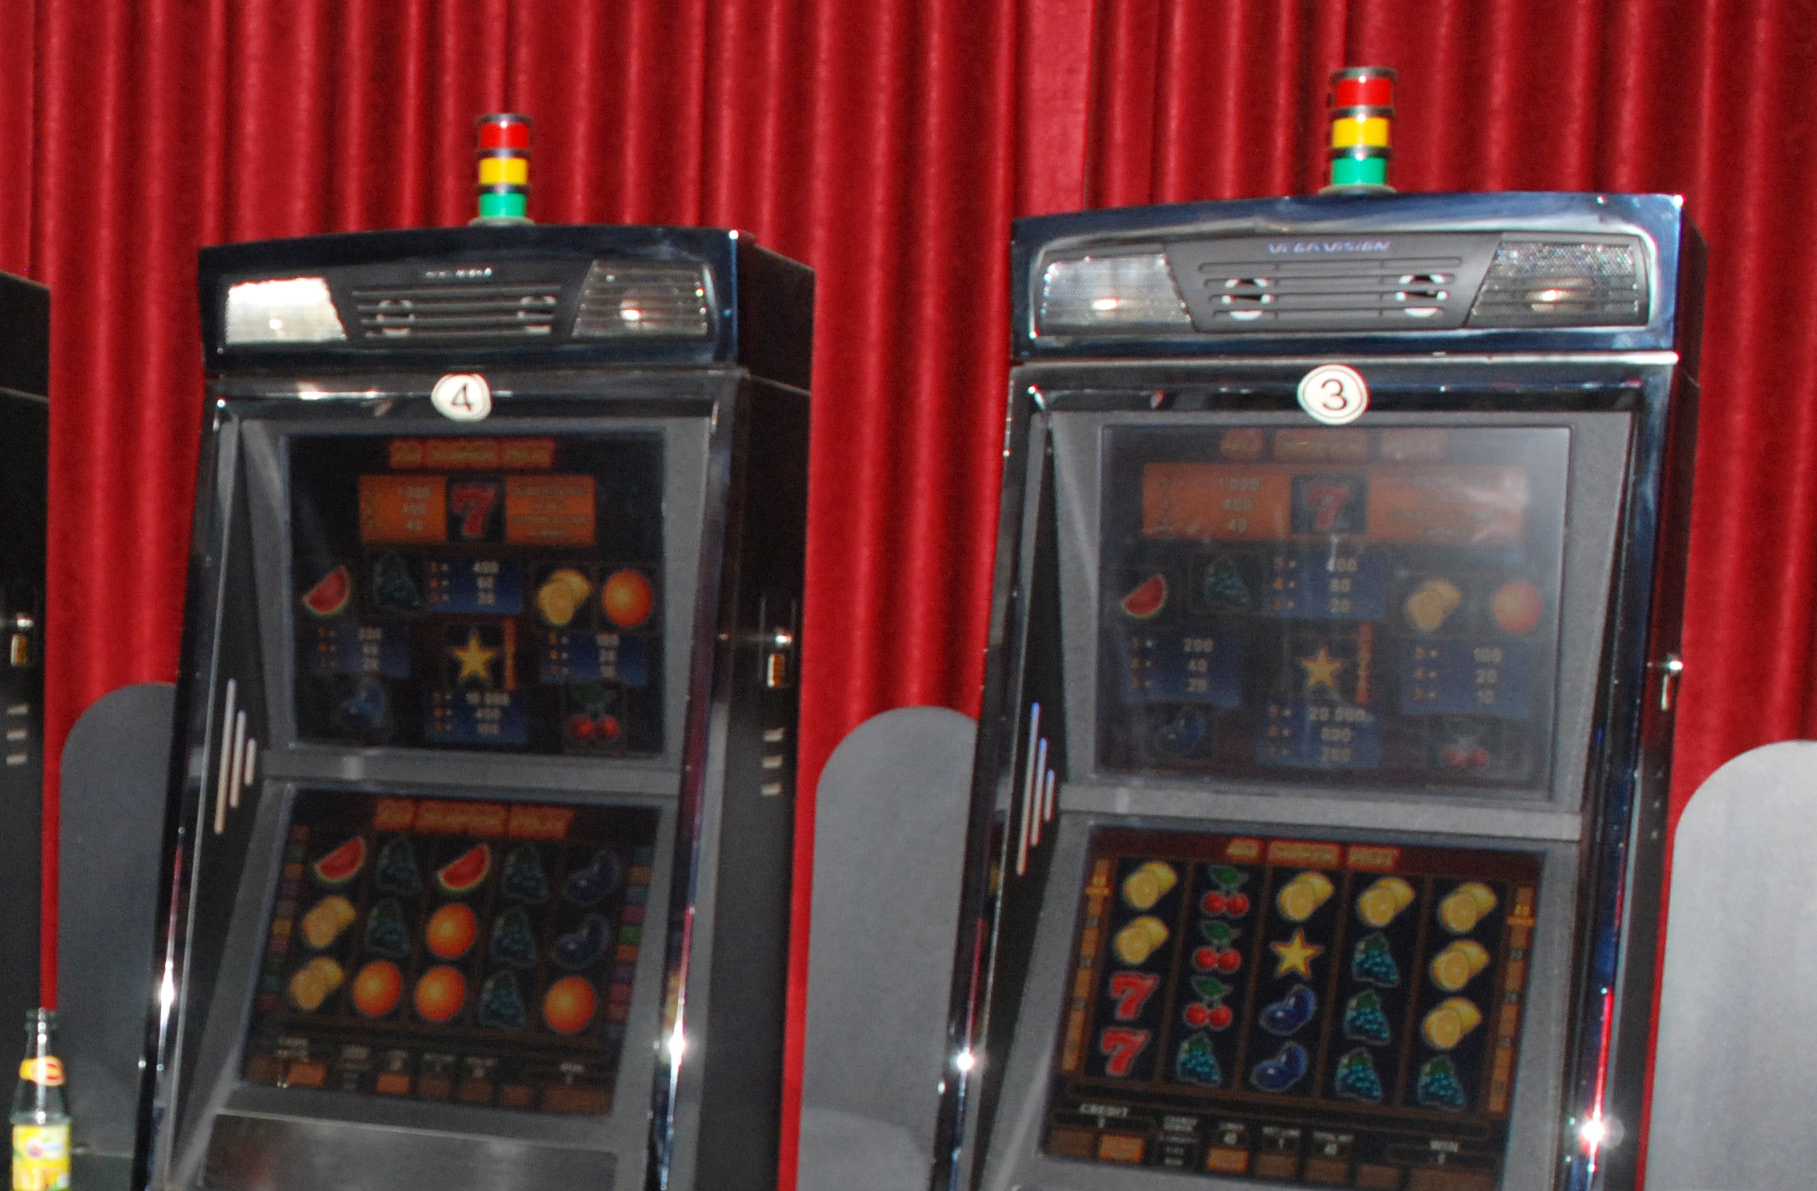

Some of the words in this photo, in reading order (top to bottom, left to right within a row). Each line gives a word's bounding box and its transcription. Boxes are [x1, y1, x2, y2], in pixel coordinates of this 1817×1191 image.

[451, 383, 472, 412] 4
[1320, 378, 1348, 411] 3
[451, 484, 498, 537] 7
[1305, 483, 1354, 531] 7
[1109, 971, 1161, 1021] 7
[1100, 1026, 1152, 1078] 7
[1079, 1103, 1130, 1119] CREDIT
